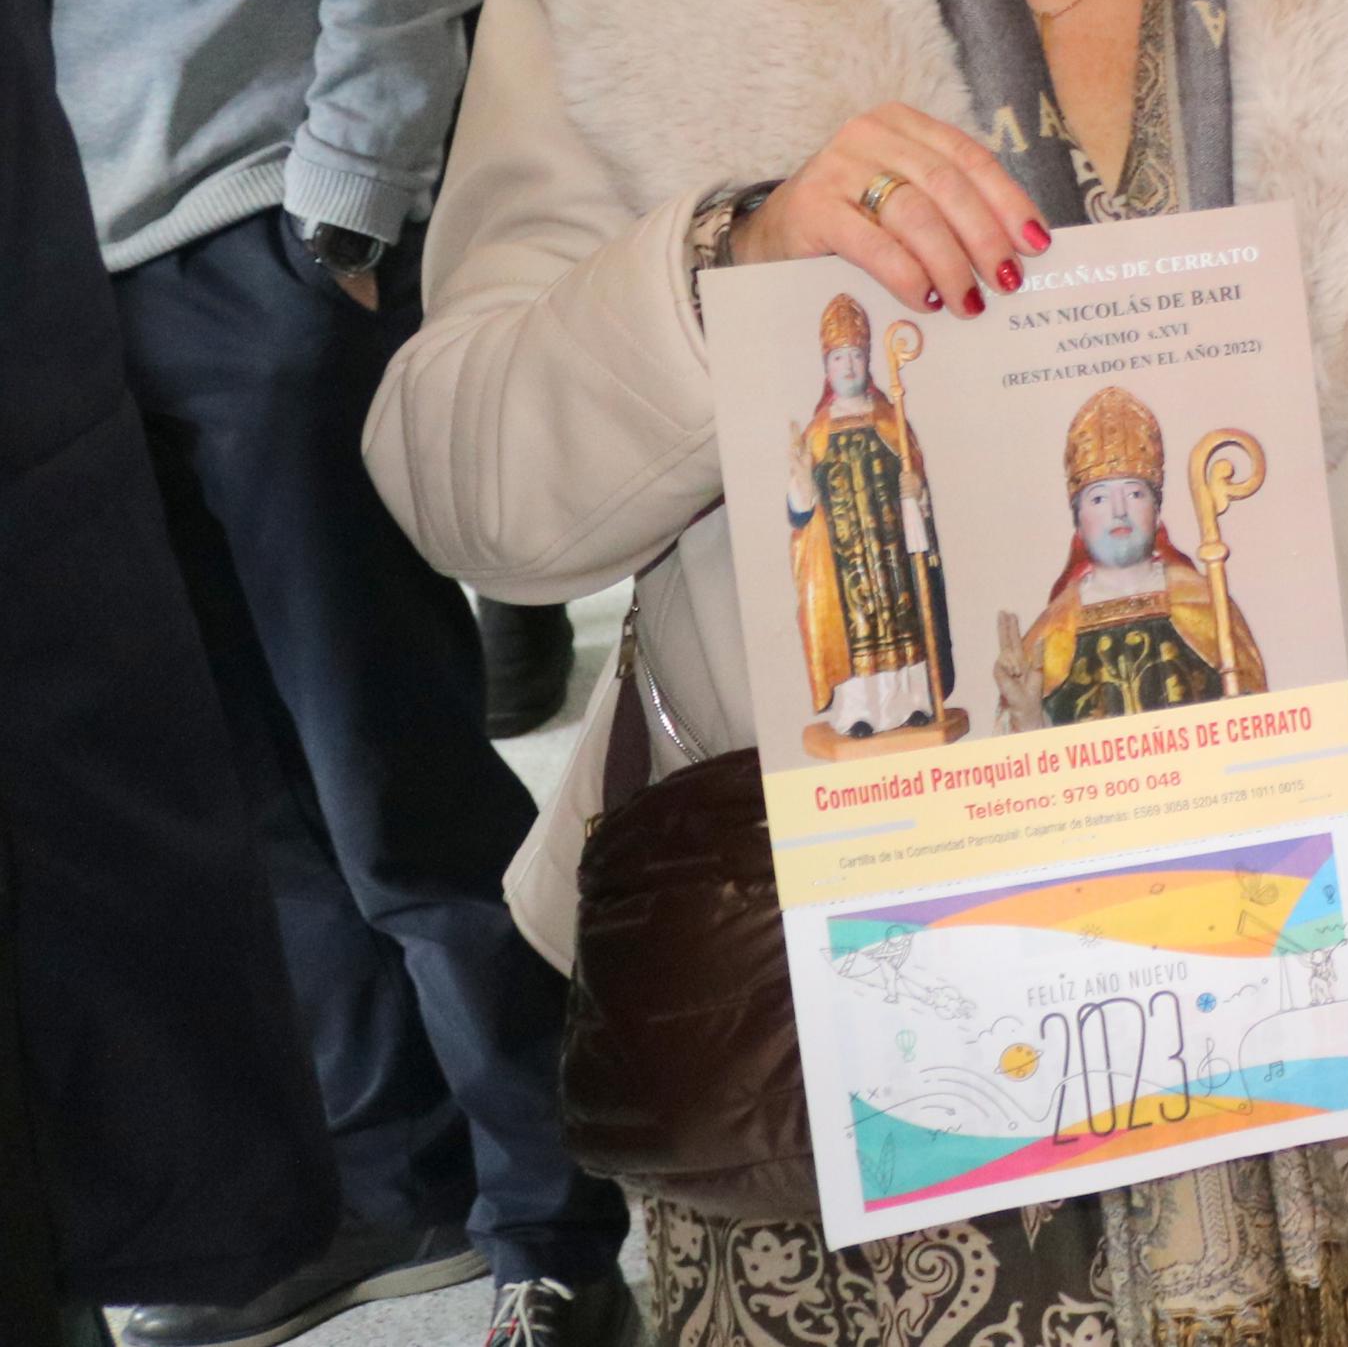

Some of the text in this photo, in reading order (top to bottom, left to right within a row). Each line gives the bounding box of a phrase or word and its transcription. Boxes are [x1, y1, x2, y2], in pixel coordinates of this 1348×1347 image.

[1123, 261, 1149, 279] DE
[1155, 246, 1259, 275] CERRATO
[1008, 284, 1242, 332] SAN NICOLÁS DE BARI
[1055, 322, 1190, 354] ANÓNIMO s.XVI
[1001, 339, 1263, 389] (RESTAURADO EN EL AÑO 2022)
[814, 706, 1313, 812] Comunidad Parroquial de VALDECAÑAS DE CERRATO
[964, 770, 1182, 821] Teléfono: 979 800 048
[839, 853, 876, 870] Cartilla
[879, 851, 893, 864] de
[894, 849, 904, 861] la
[906, 838, 965, 859] Comunidad
[1071, 816, 1083, 831] de
[1085, 970, 1120, 998] AÑO
[1129, 960, 1189, 989] NUEVO
[1040, 990, 1191, 1146] 2023
